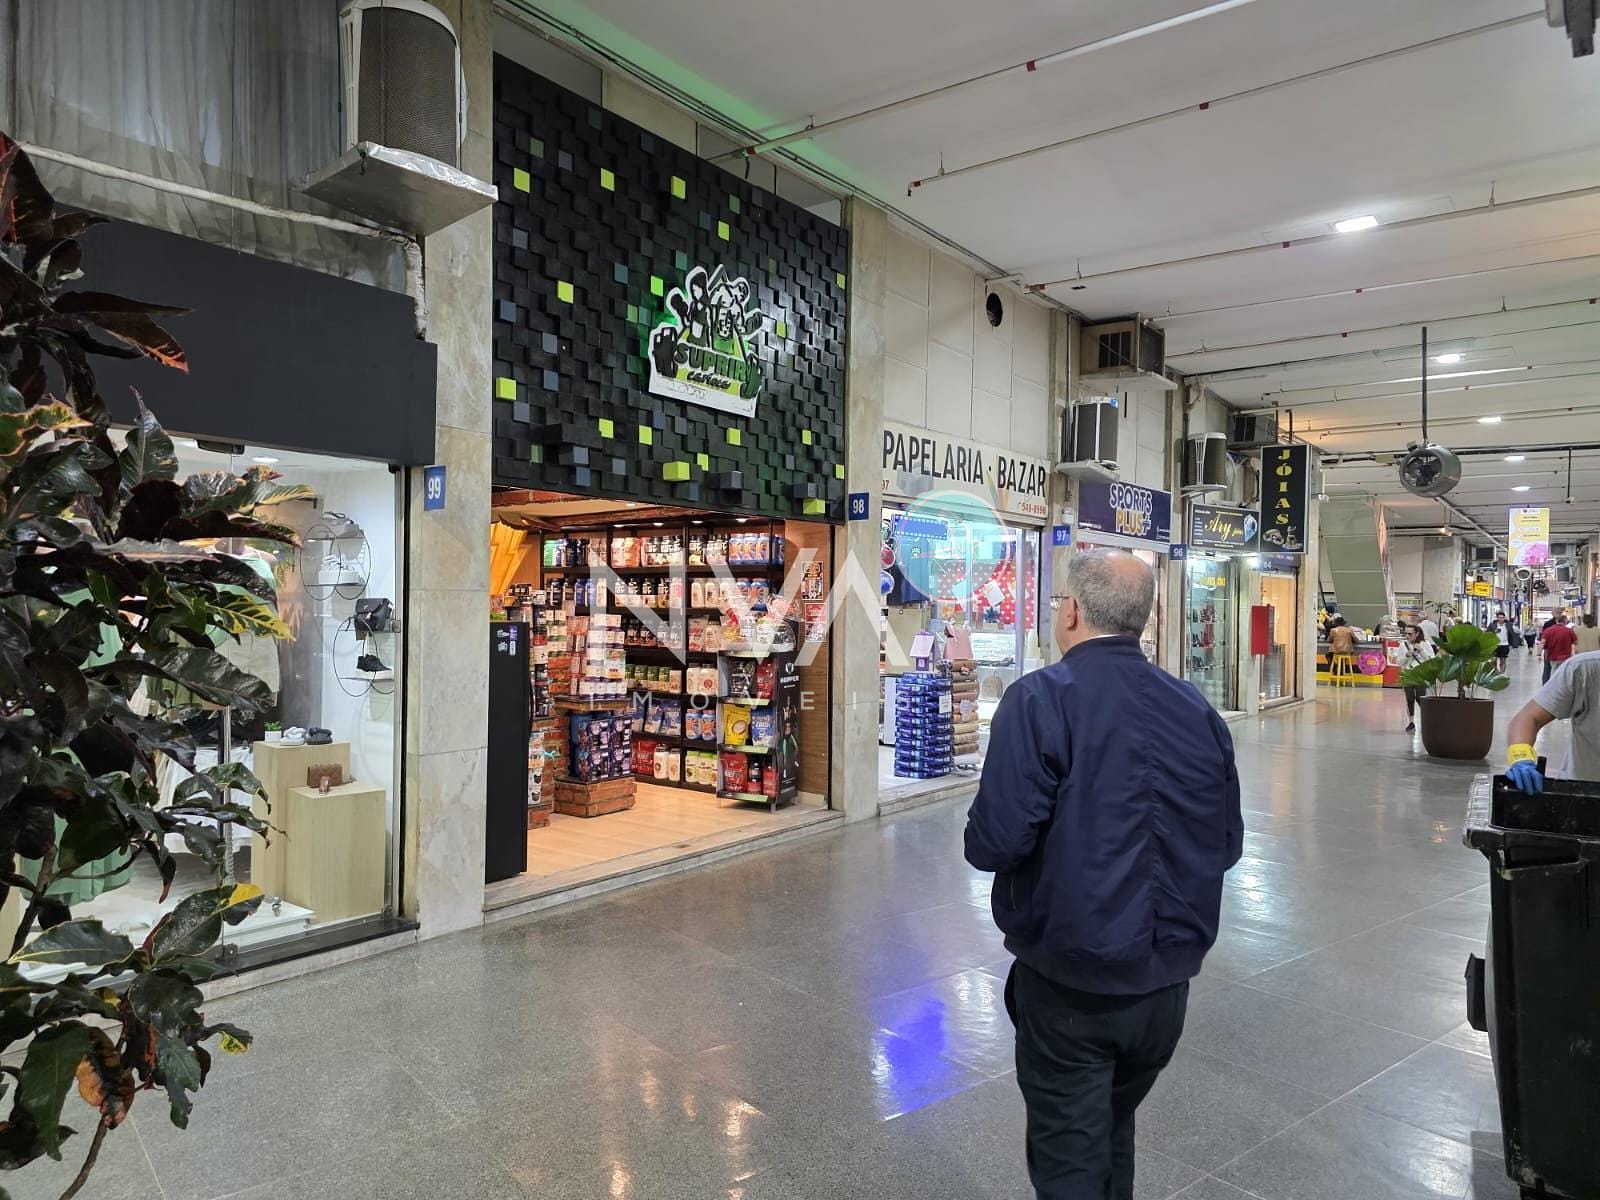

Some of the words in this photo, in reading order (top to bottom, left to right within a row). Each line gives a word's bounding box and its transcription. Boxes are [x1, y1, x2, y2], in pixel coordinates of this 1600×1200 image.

[882, 429, 985, 485] PAPELARIA
[997, 455, 1047, 498] BAZAR
[428, 476, 442, 500] 99
[1109, 483, 1153, 515] SPORTS
[1274, 449, 1293, 525] JÓIAS
[852, 499, 865, 514] 98
[1056, 529, 1067, 541] 97
[1173, 547, 1184, 557] 96
